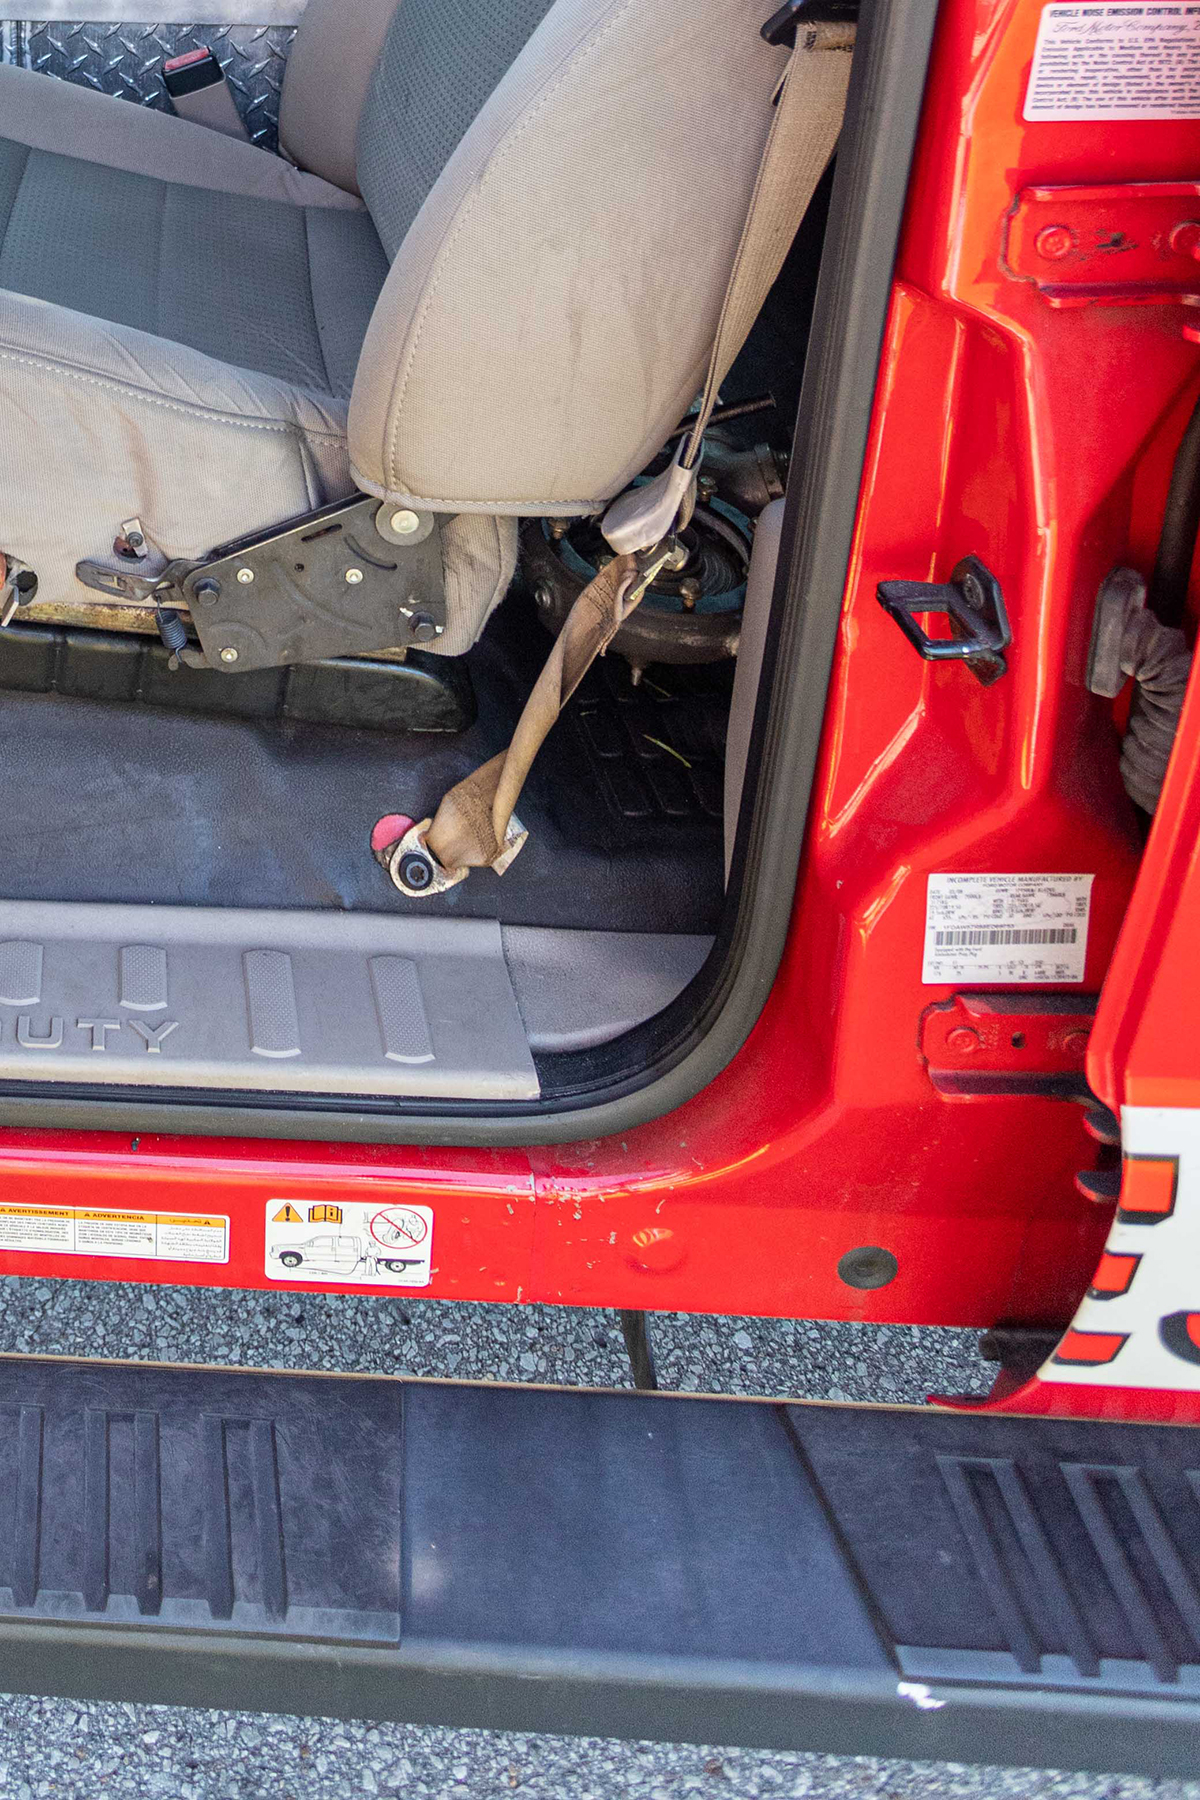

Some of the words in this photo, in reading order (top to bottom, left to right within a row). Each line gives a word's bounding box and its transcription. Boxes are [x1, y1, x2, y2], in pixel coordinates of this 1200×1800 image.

[1050, 9, 1080, 17] VEHICLE
[1107, 8, 1144, 16] EMISSION
[1147, 8, 1182, 16] CONTROL
[1052, 21, 1086, 33] Ford
[1080, 20, 1123, 35] Motor
[8, 1208, 69, 1216] AVERTISSEMENT
[92, 1213, 145, 1221] ADVERTENCIA
